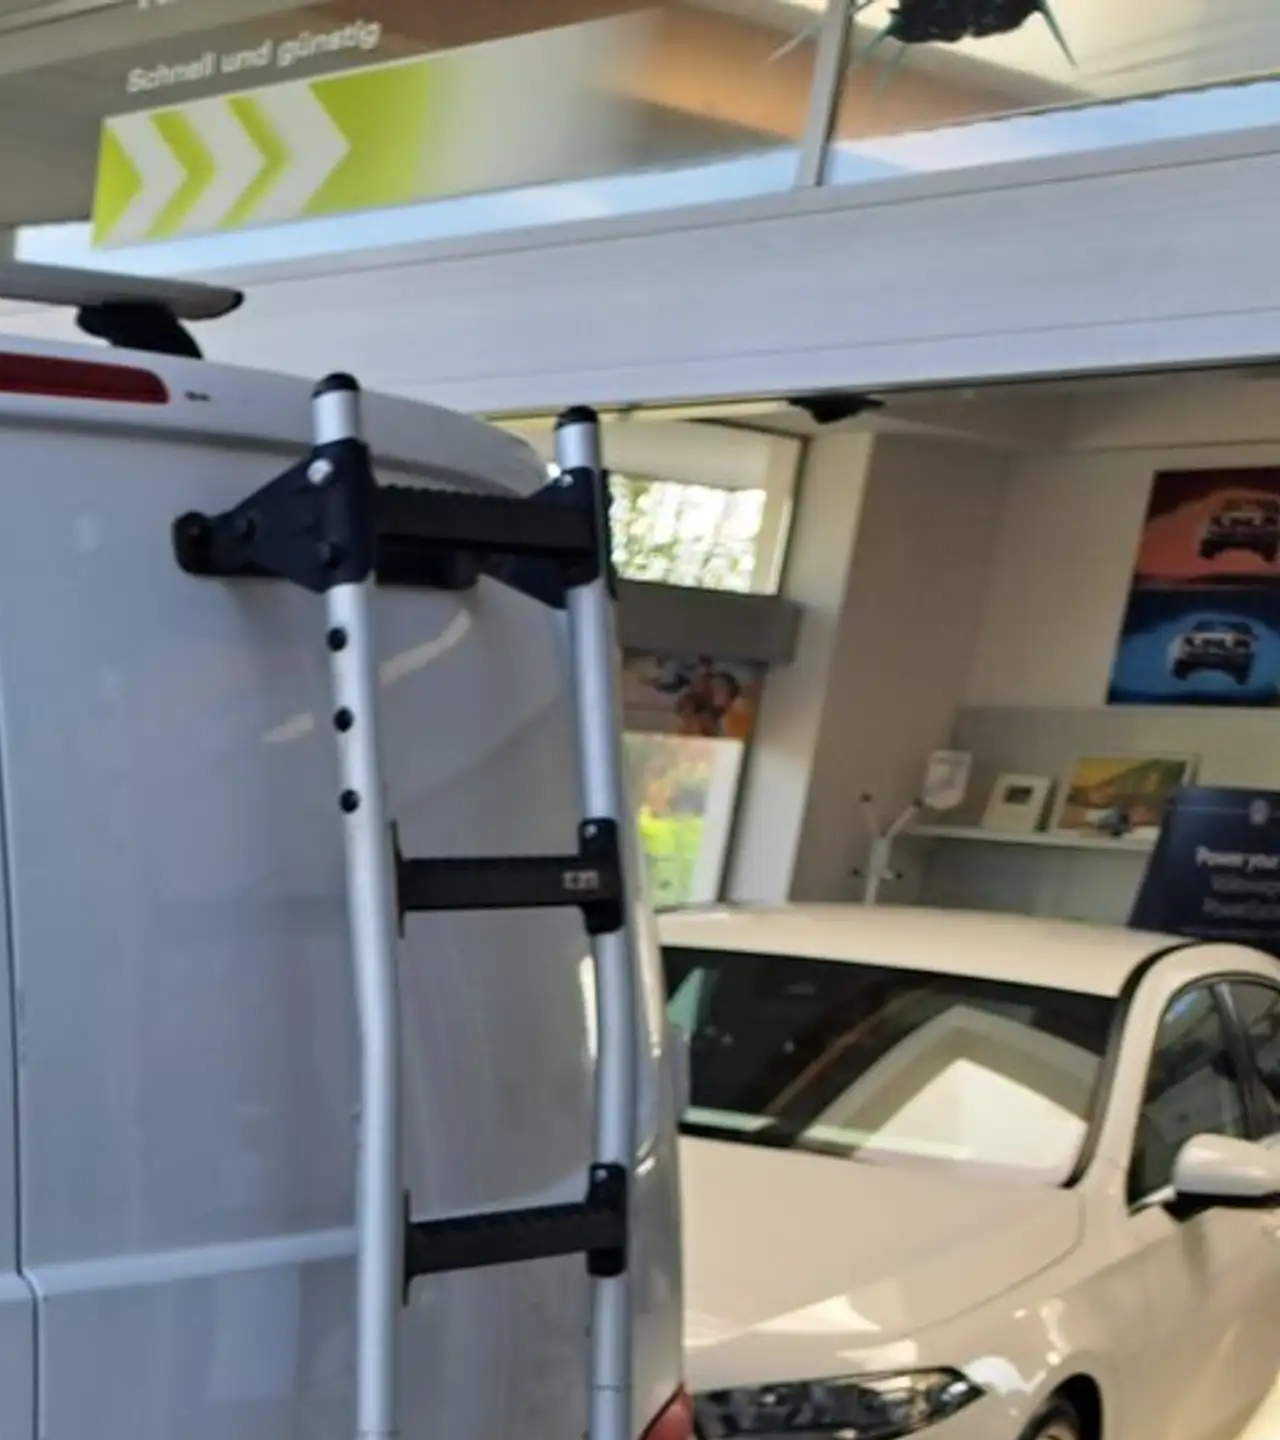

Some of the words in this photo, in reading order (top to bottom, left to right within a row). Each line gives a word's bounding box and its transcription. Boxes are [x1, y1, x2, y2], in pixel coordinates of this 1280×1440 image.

[126, 52, 217, 93] Schnell
[221, 39, 274, 73] und
[276, 20, 382, 68] günstig
